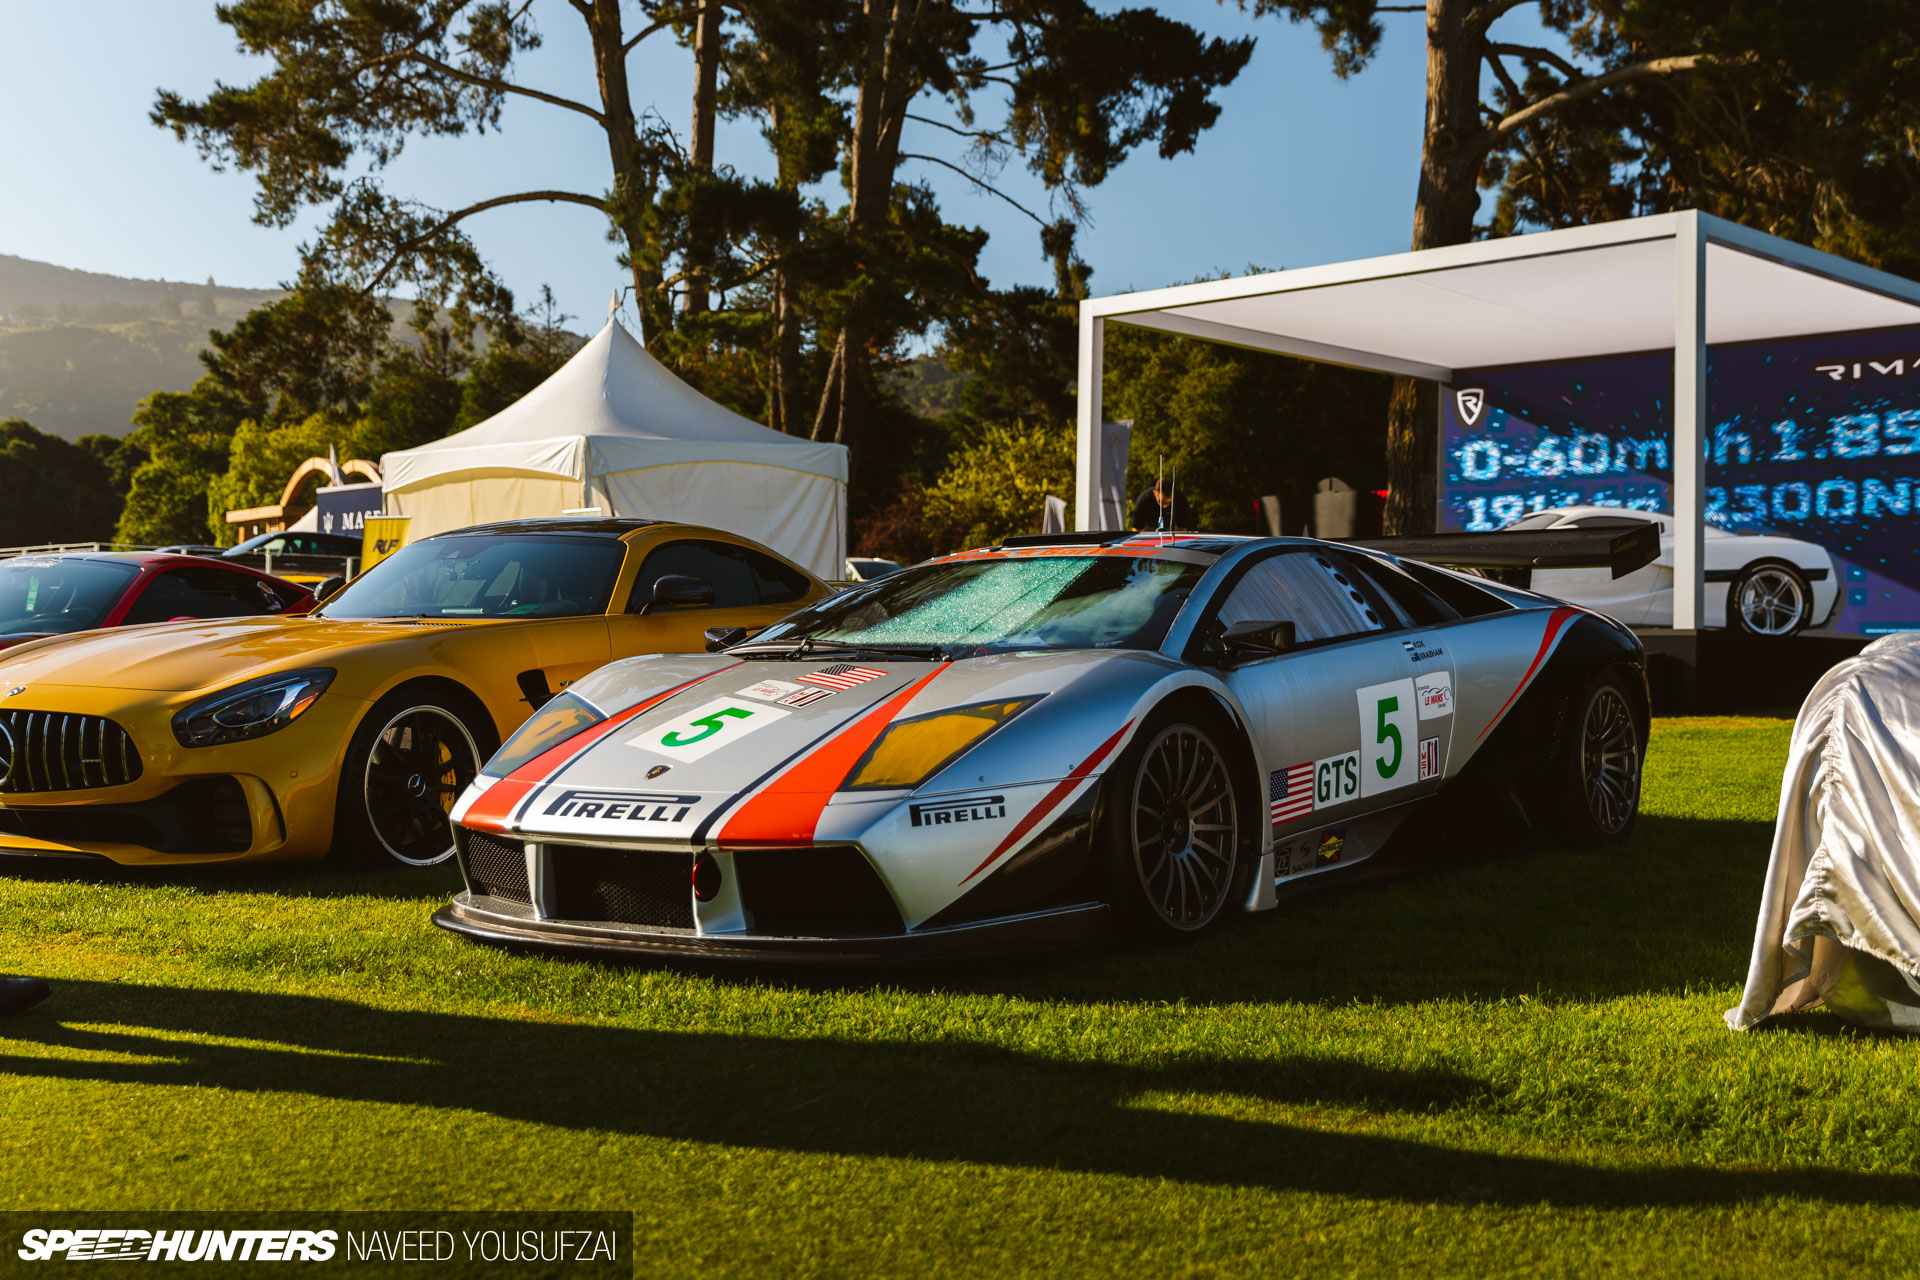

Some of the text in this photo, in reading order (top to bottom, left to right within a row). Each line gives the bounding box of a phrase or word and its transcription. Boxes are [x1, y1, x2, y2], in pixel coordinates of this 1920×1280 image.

[1815, 359, 1920, 380] RIM
[1459, 422, 1751, 480] 0-60mh
[1703, 478, 1920, 520] 2300N
[372, 538, 400, 555] RUF
[1425, 696, 1430, 706] LE
[661, 707, 755, 748] 5
[1375, 696, 1403, 780] 5
[1317, 755, 1357, 803] GTS
[543, 790, 702, 823] PIRELLI
[909, 795, 1006, 828] PIRELLI
[1291, 861, 1313, 873] SACHS
